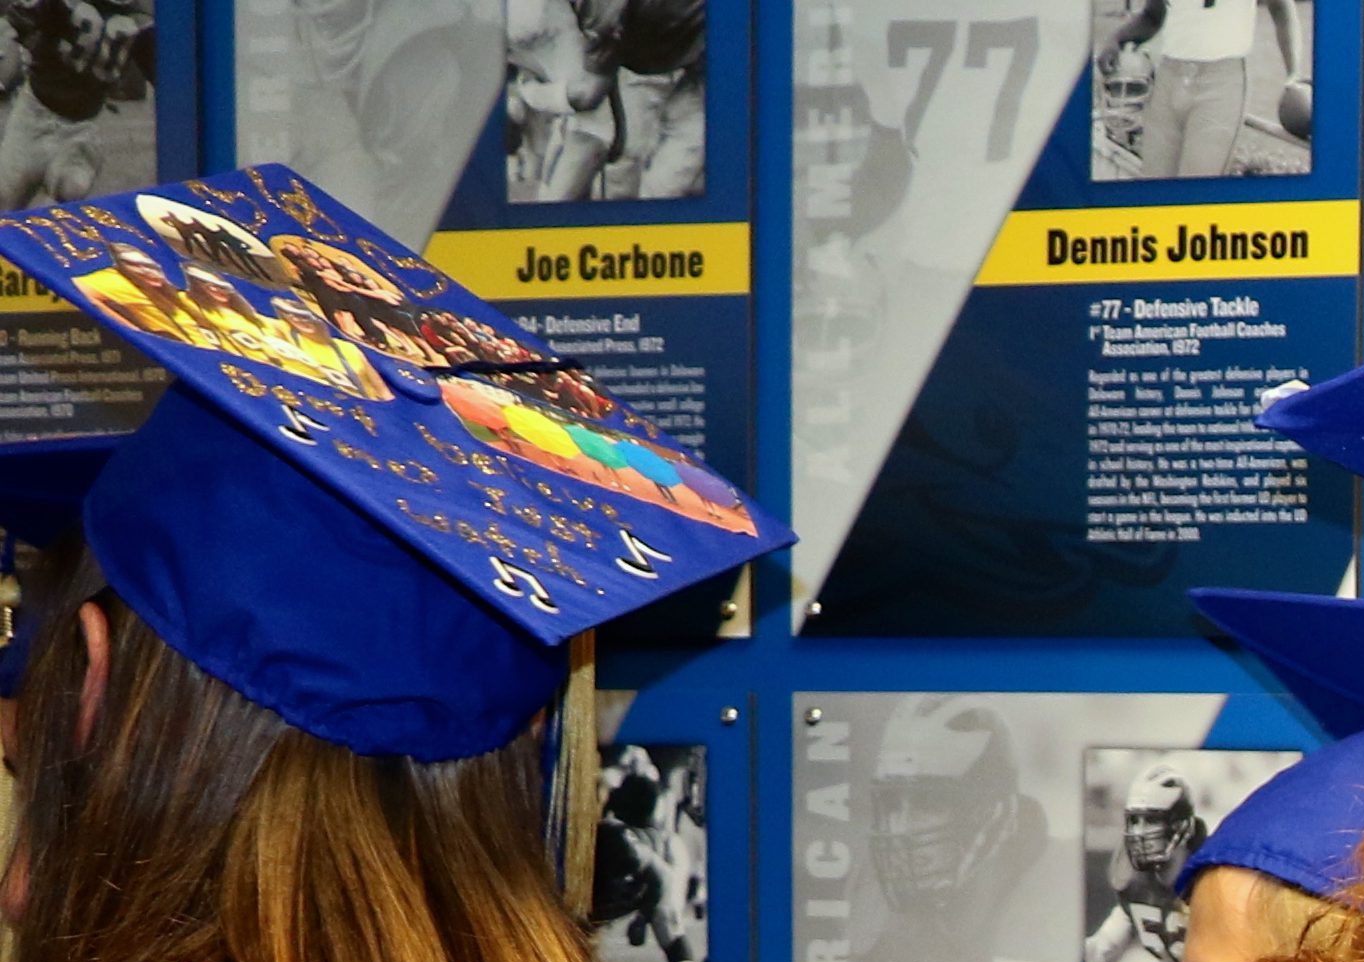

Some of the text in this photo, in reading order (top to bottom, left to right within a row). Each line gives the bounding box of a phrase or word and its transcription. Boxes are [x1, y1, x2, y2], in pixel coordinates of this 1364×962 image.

[887, 17, 1041, 164] 77
[1047, 224, 1309, 266] Dennis Johnson
[516, 243, 704, 284] Joe Carbone
[613, 313, 640, 333] End
[1090, 299, 1123, 320] #77
[1134, 297, 1209, 320] Defensive
[1212, 295, 1260, 318] Tackle
[1103, 325, 1133, 340] Team
[1135, 323, 1188, 339] American
[1190, 321, 1236, 337] Football
[1238, 320, 1287, 336] Coaches
